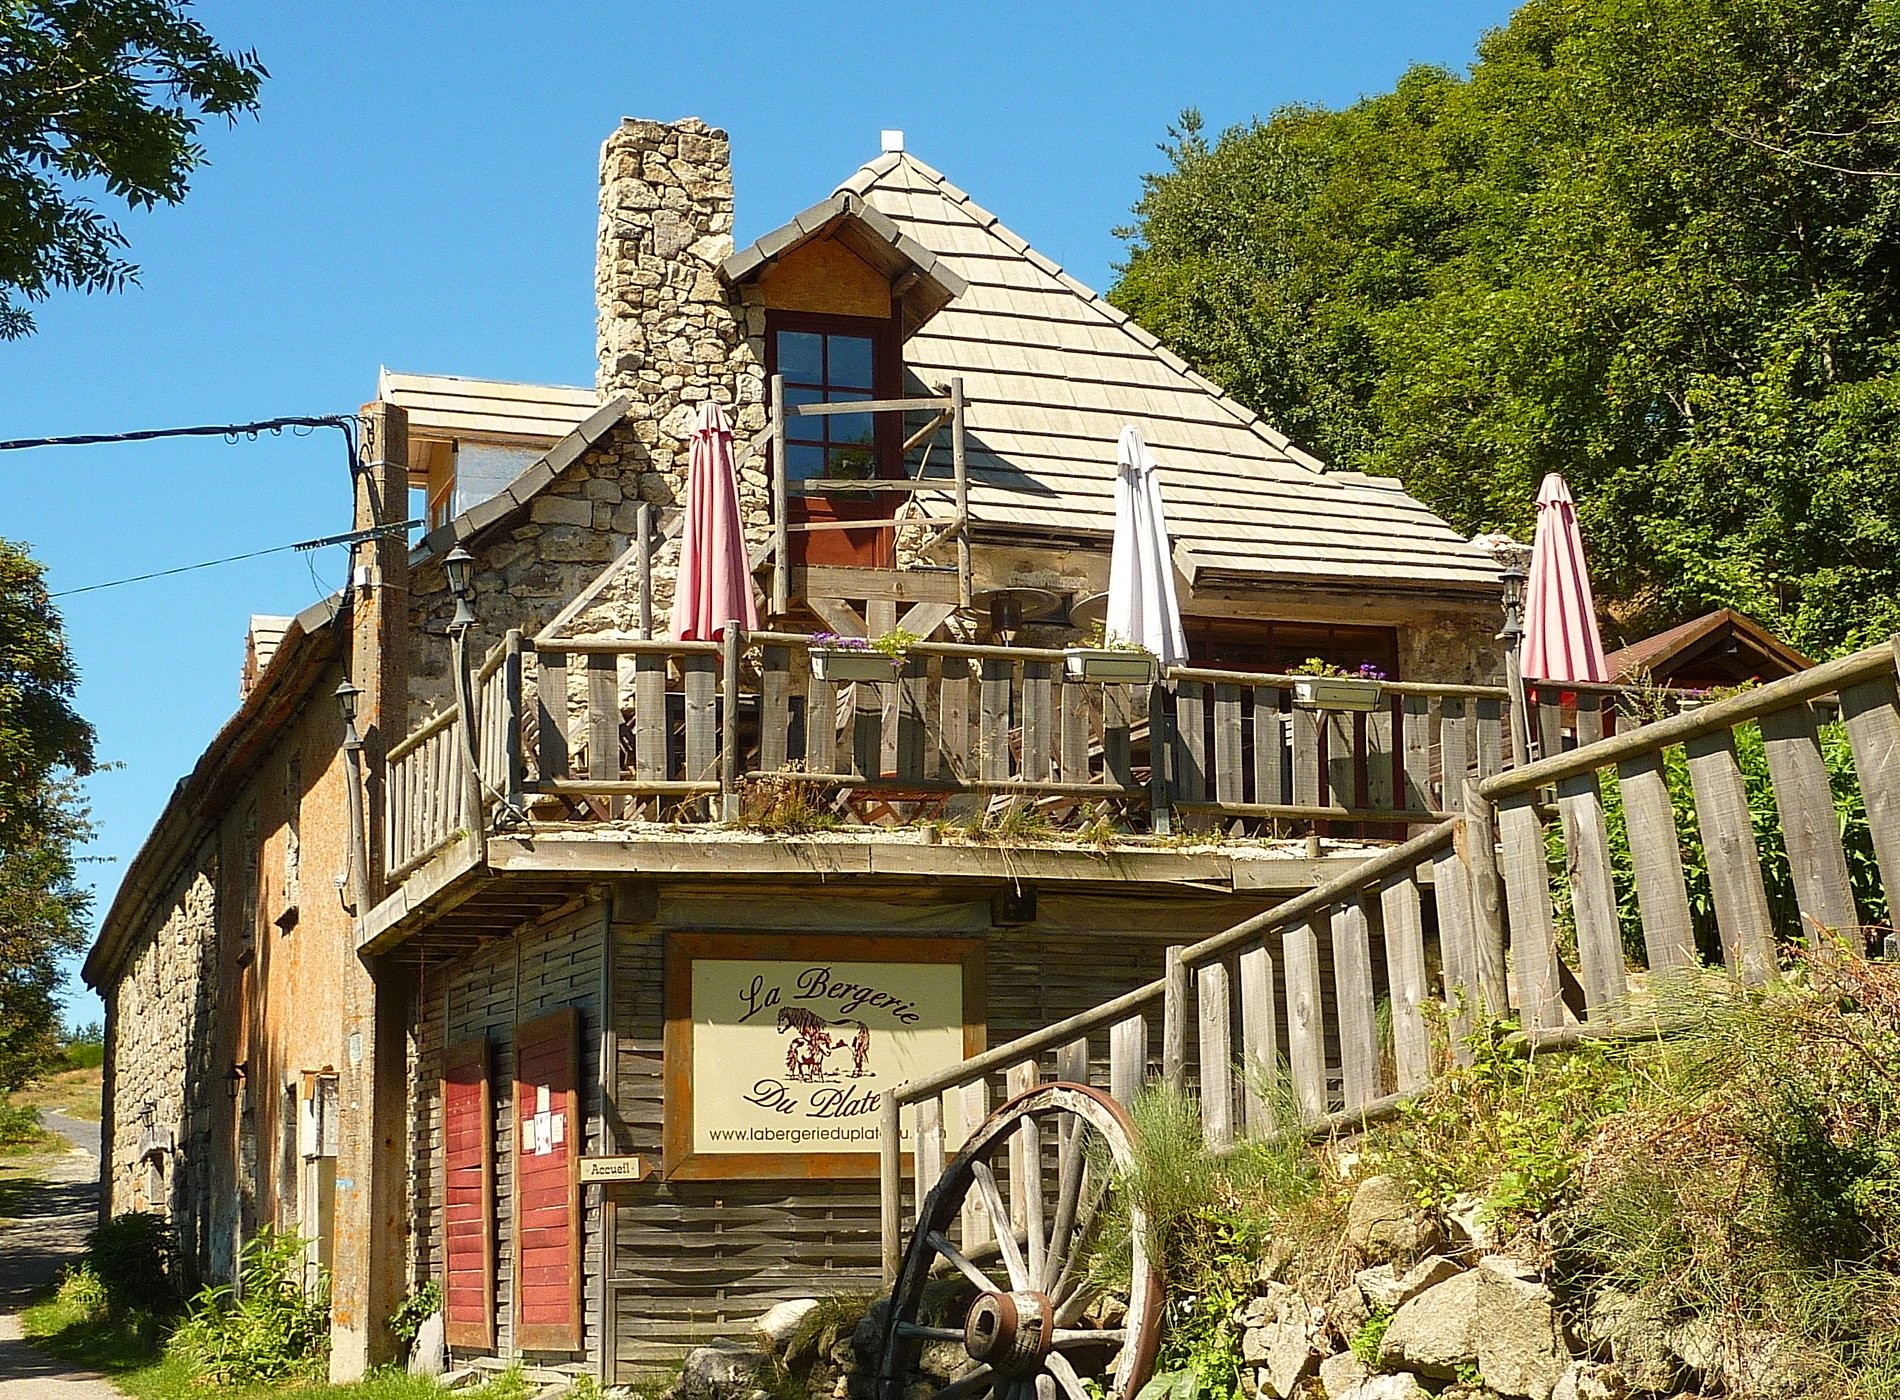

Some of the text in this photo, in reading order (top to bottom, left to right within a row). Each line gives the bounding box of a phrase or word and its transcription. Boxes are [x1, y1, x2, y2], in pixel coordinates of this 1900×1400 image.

[738, 966, 920, 1025] La Bergerie
[743, 1079, 914, 1119] Du Plate
[591, 1162, 630, 1175] Accueil
